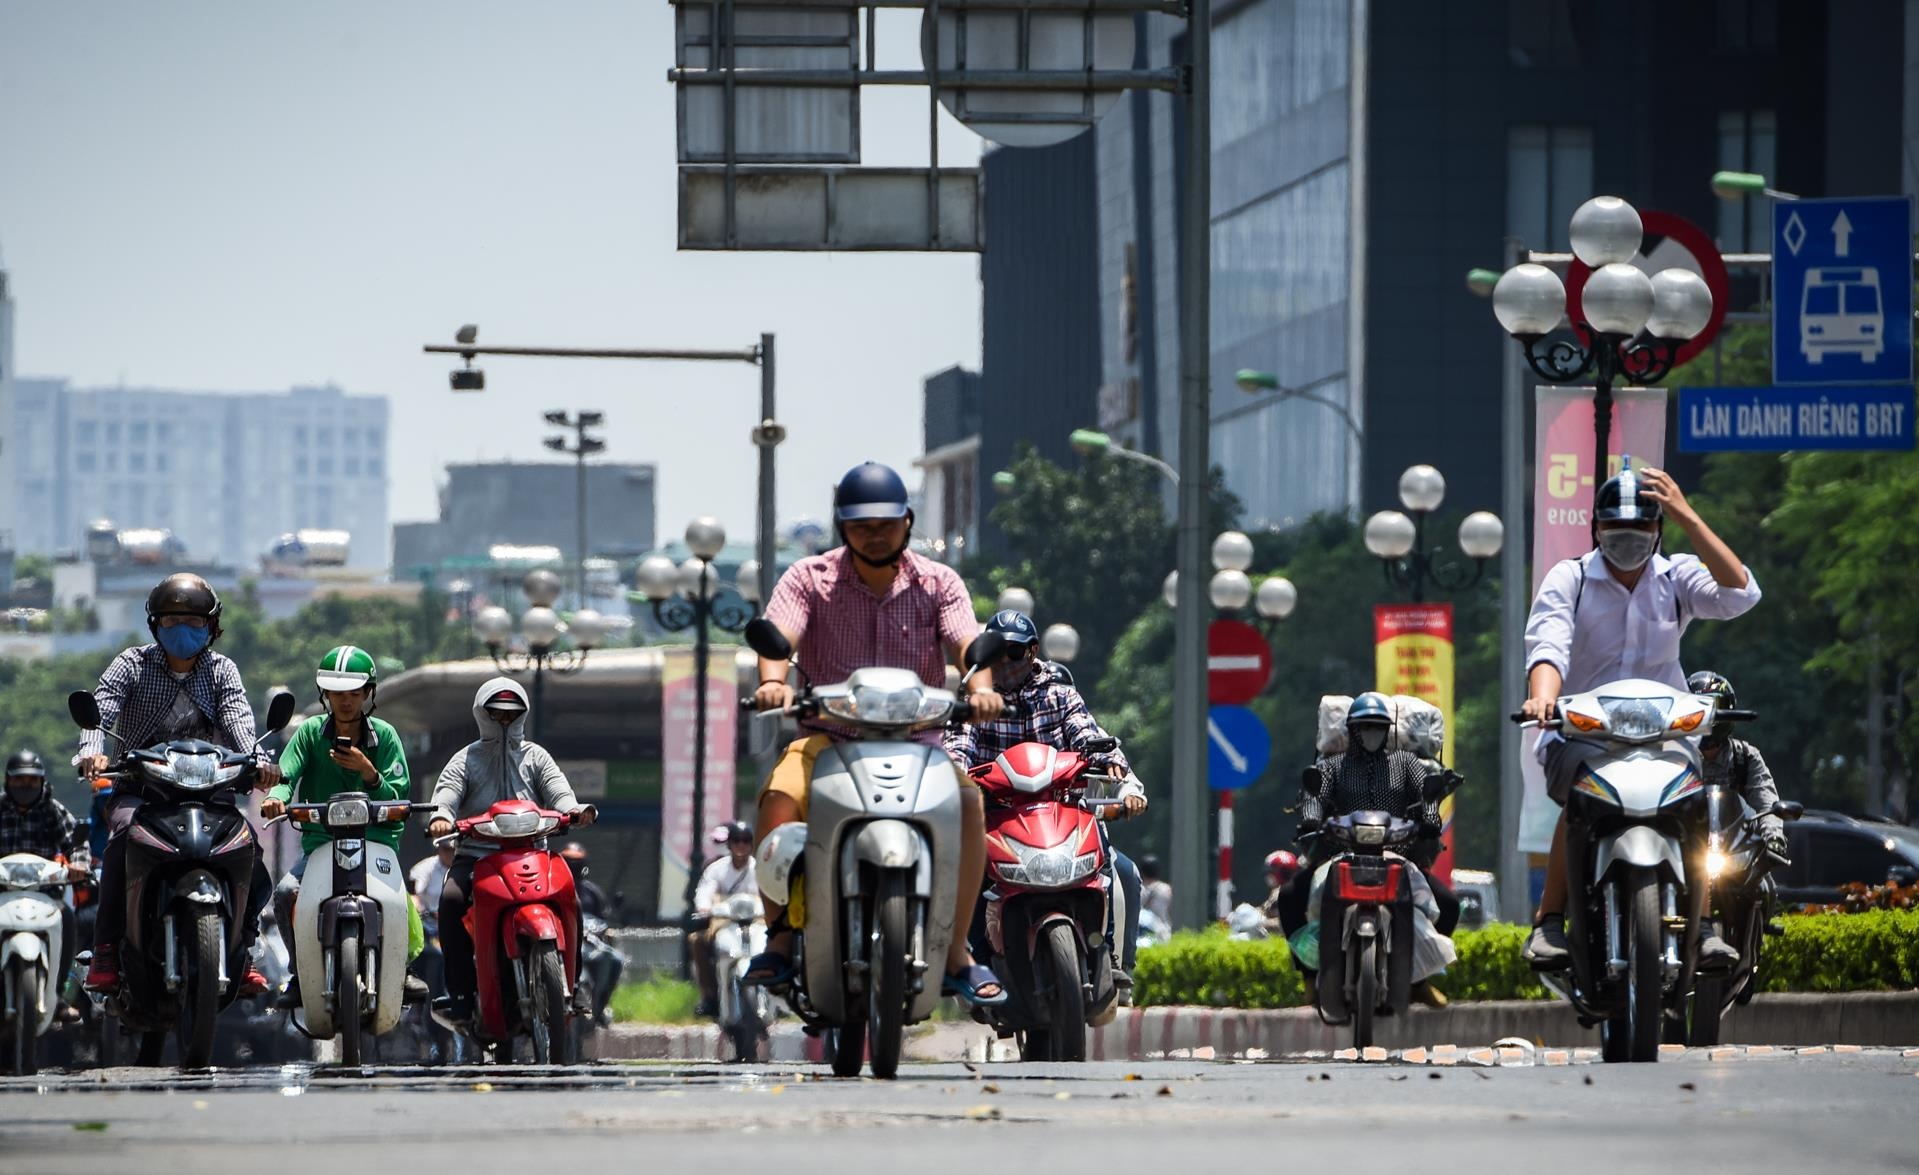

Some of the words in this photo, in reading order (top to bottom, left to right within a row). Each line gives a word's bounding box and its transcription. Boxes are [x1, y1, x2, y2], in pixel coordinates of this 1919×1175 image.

[1691, 397, 1730, 437] LÀN
[1737, 396, 1793, 437] DÀNH
[1797, 395, 1860, 437] RIÊNG
[1865, 403, 1904, 437] BRT
